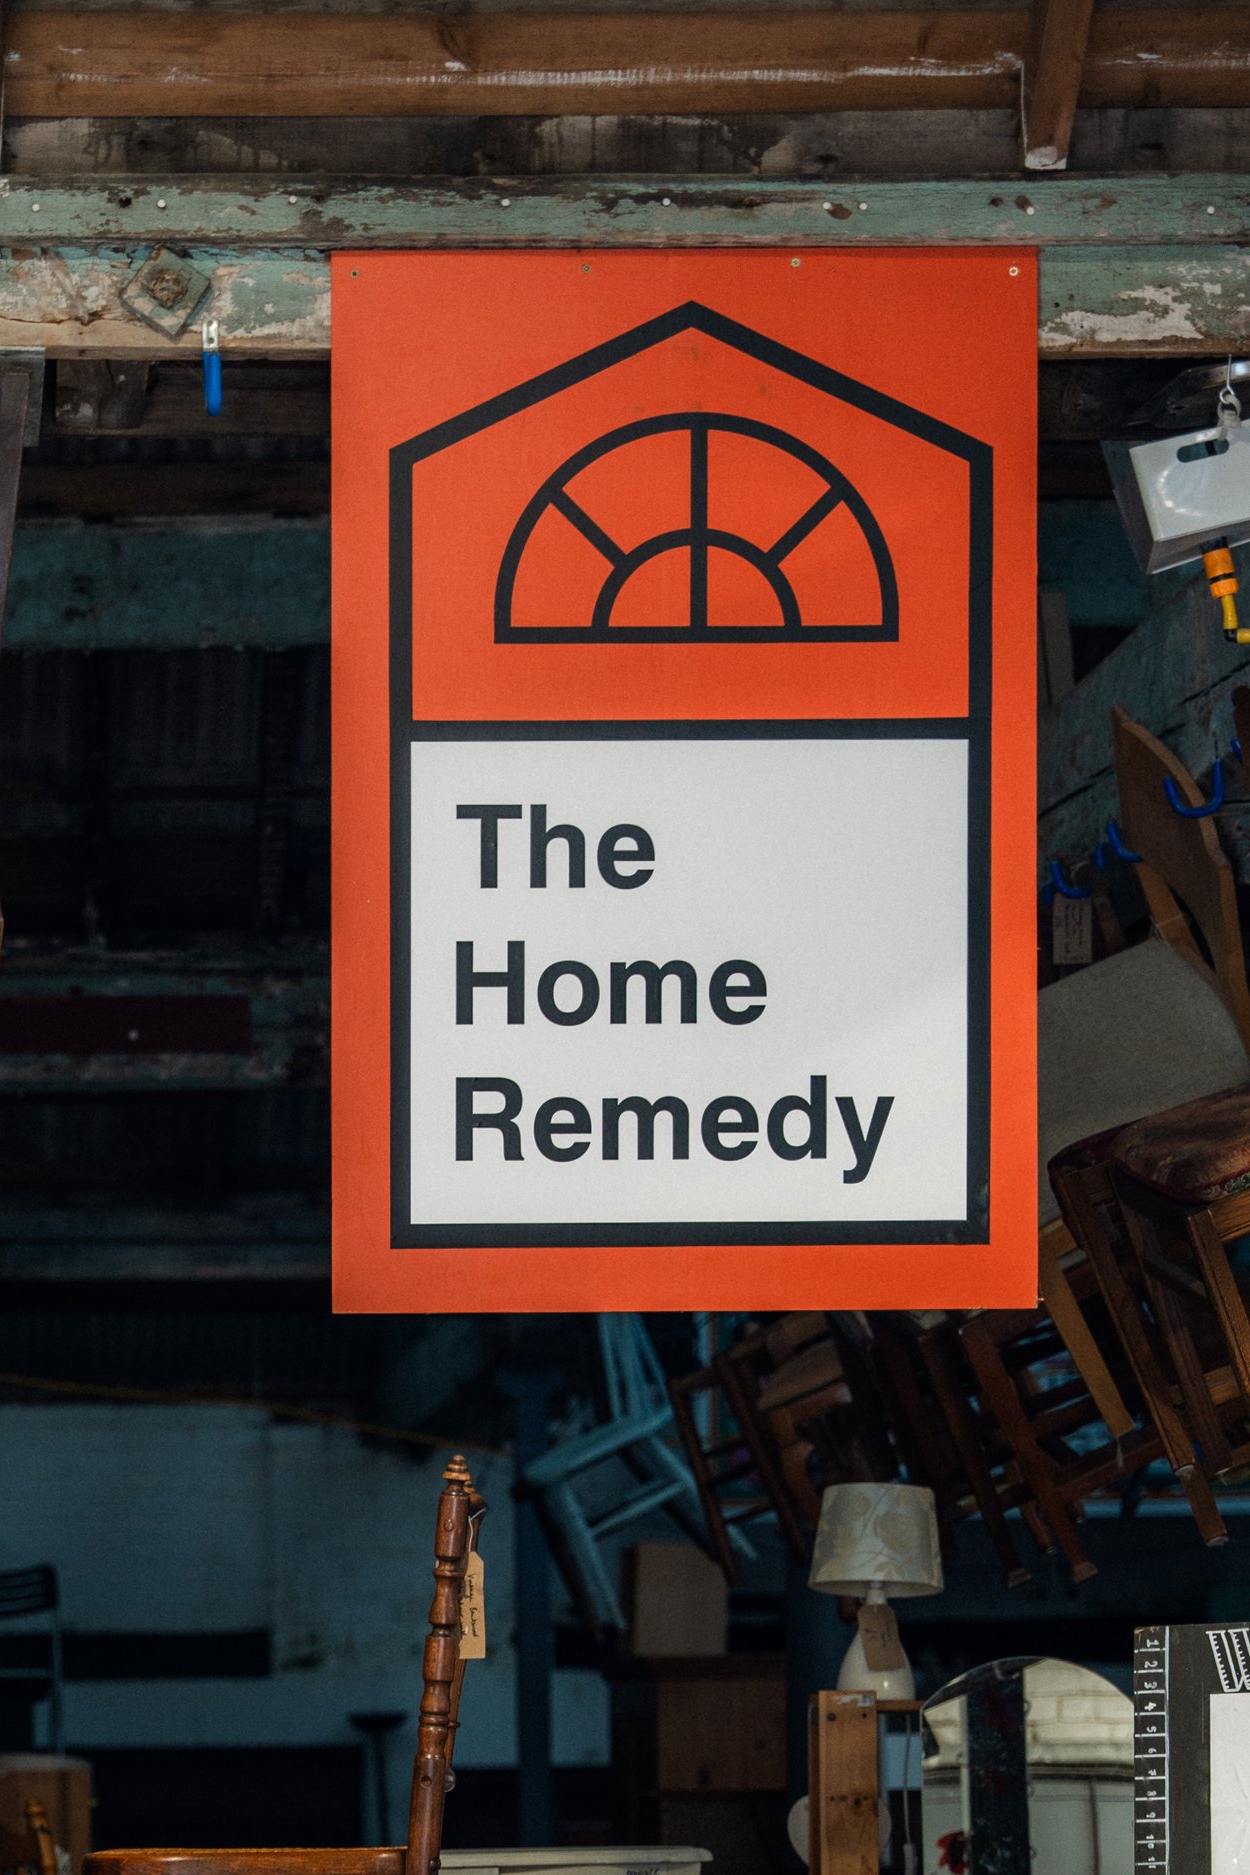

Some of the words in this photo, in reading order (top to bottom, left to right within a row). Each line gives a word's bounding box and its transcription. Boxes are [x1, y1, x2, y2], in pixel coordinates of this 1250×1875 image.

[455, 804, 655, 889] The
[455, 940, 768, 1027] Home
[455, 1074, 895, 1185] Remedy
[1146, 1638, 1159, 1647] 1
[1144, 1660, 1158, 1668] 2
[1144, 1701, 1156, 1711] 4
[1145, 1834, 1154, 1848] 10
[1147, 1856, 1156, 1868] 11
